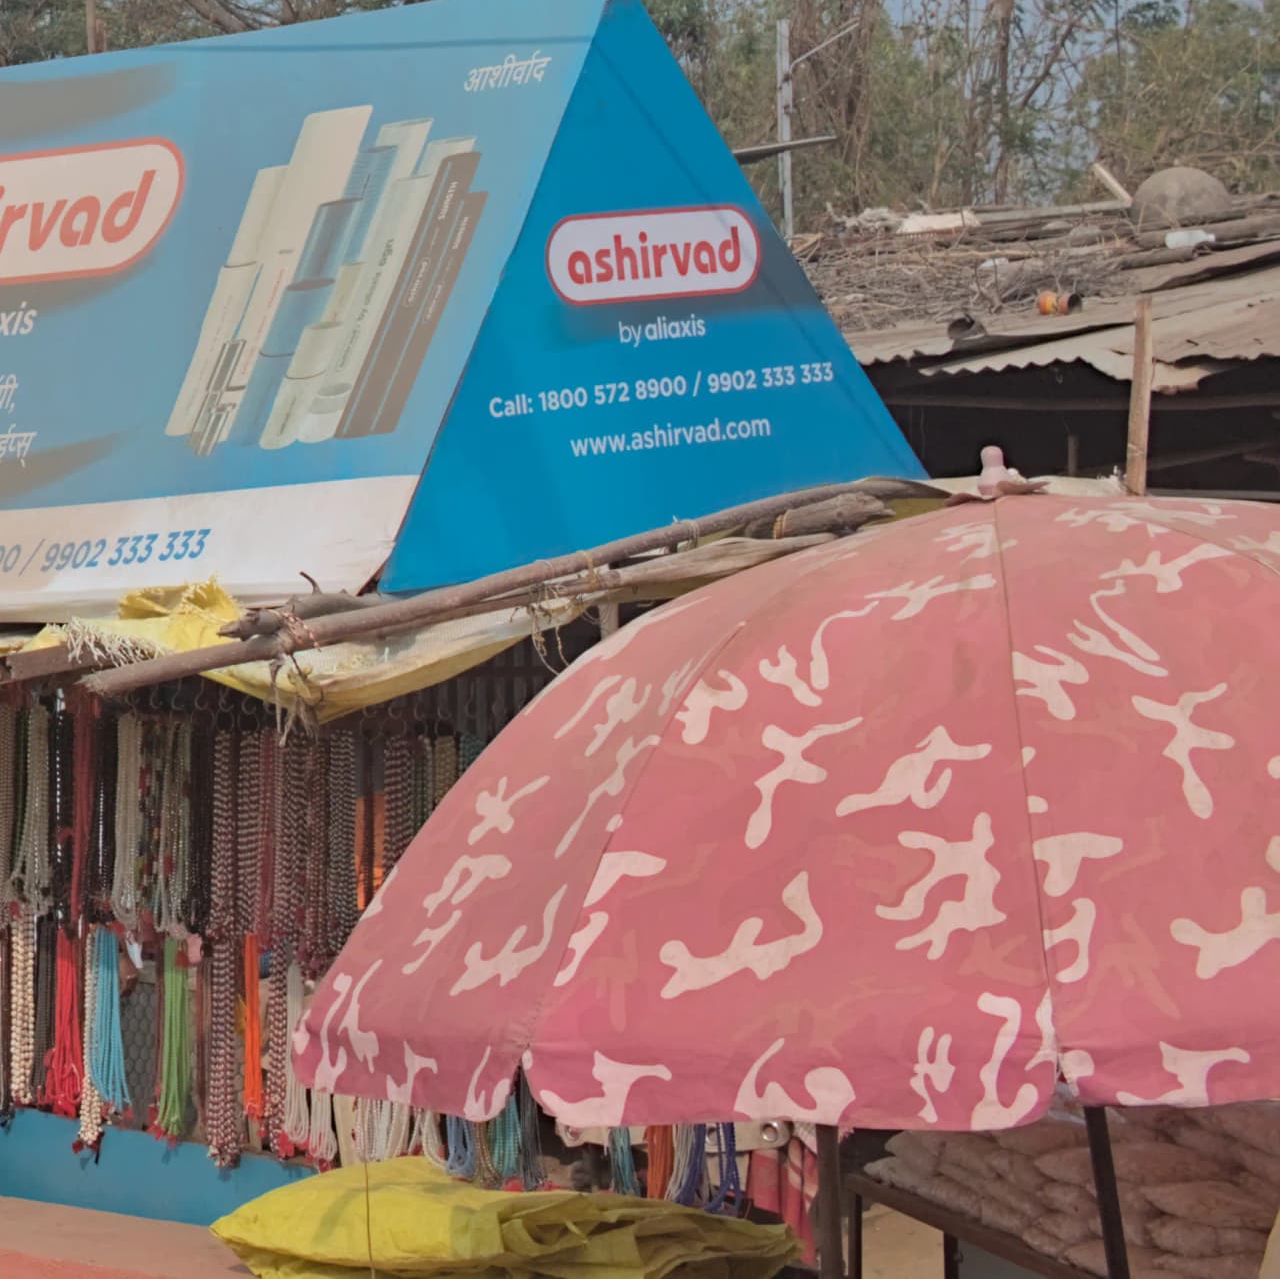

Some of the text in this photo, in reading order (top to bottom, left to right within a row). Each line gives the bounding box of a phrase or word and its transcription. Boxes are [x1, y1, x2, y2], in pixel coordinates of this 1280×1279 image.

[464, 49, 552, 92] आशीर्वाद
[567, 225, 741, 285] ashirvad
[618, 313, 706, 347] by aliaxis
[489, 361, 833, 418] Call: 1800 572 8900 / 9902 333 333
[570, 417, 771, 457] www.ashirvad.com
[18, 538, 45, 577] /
[40, 538, 107, 572] 9902
[107, 533, 159, 566] 333
[158, 528, 212, 561] 333
